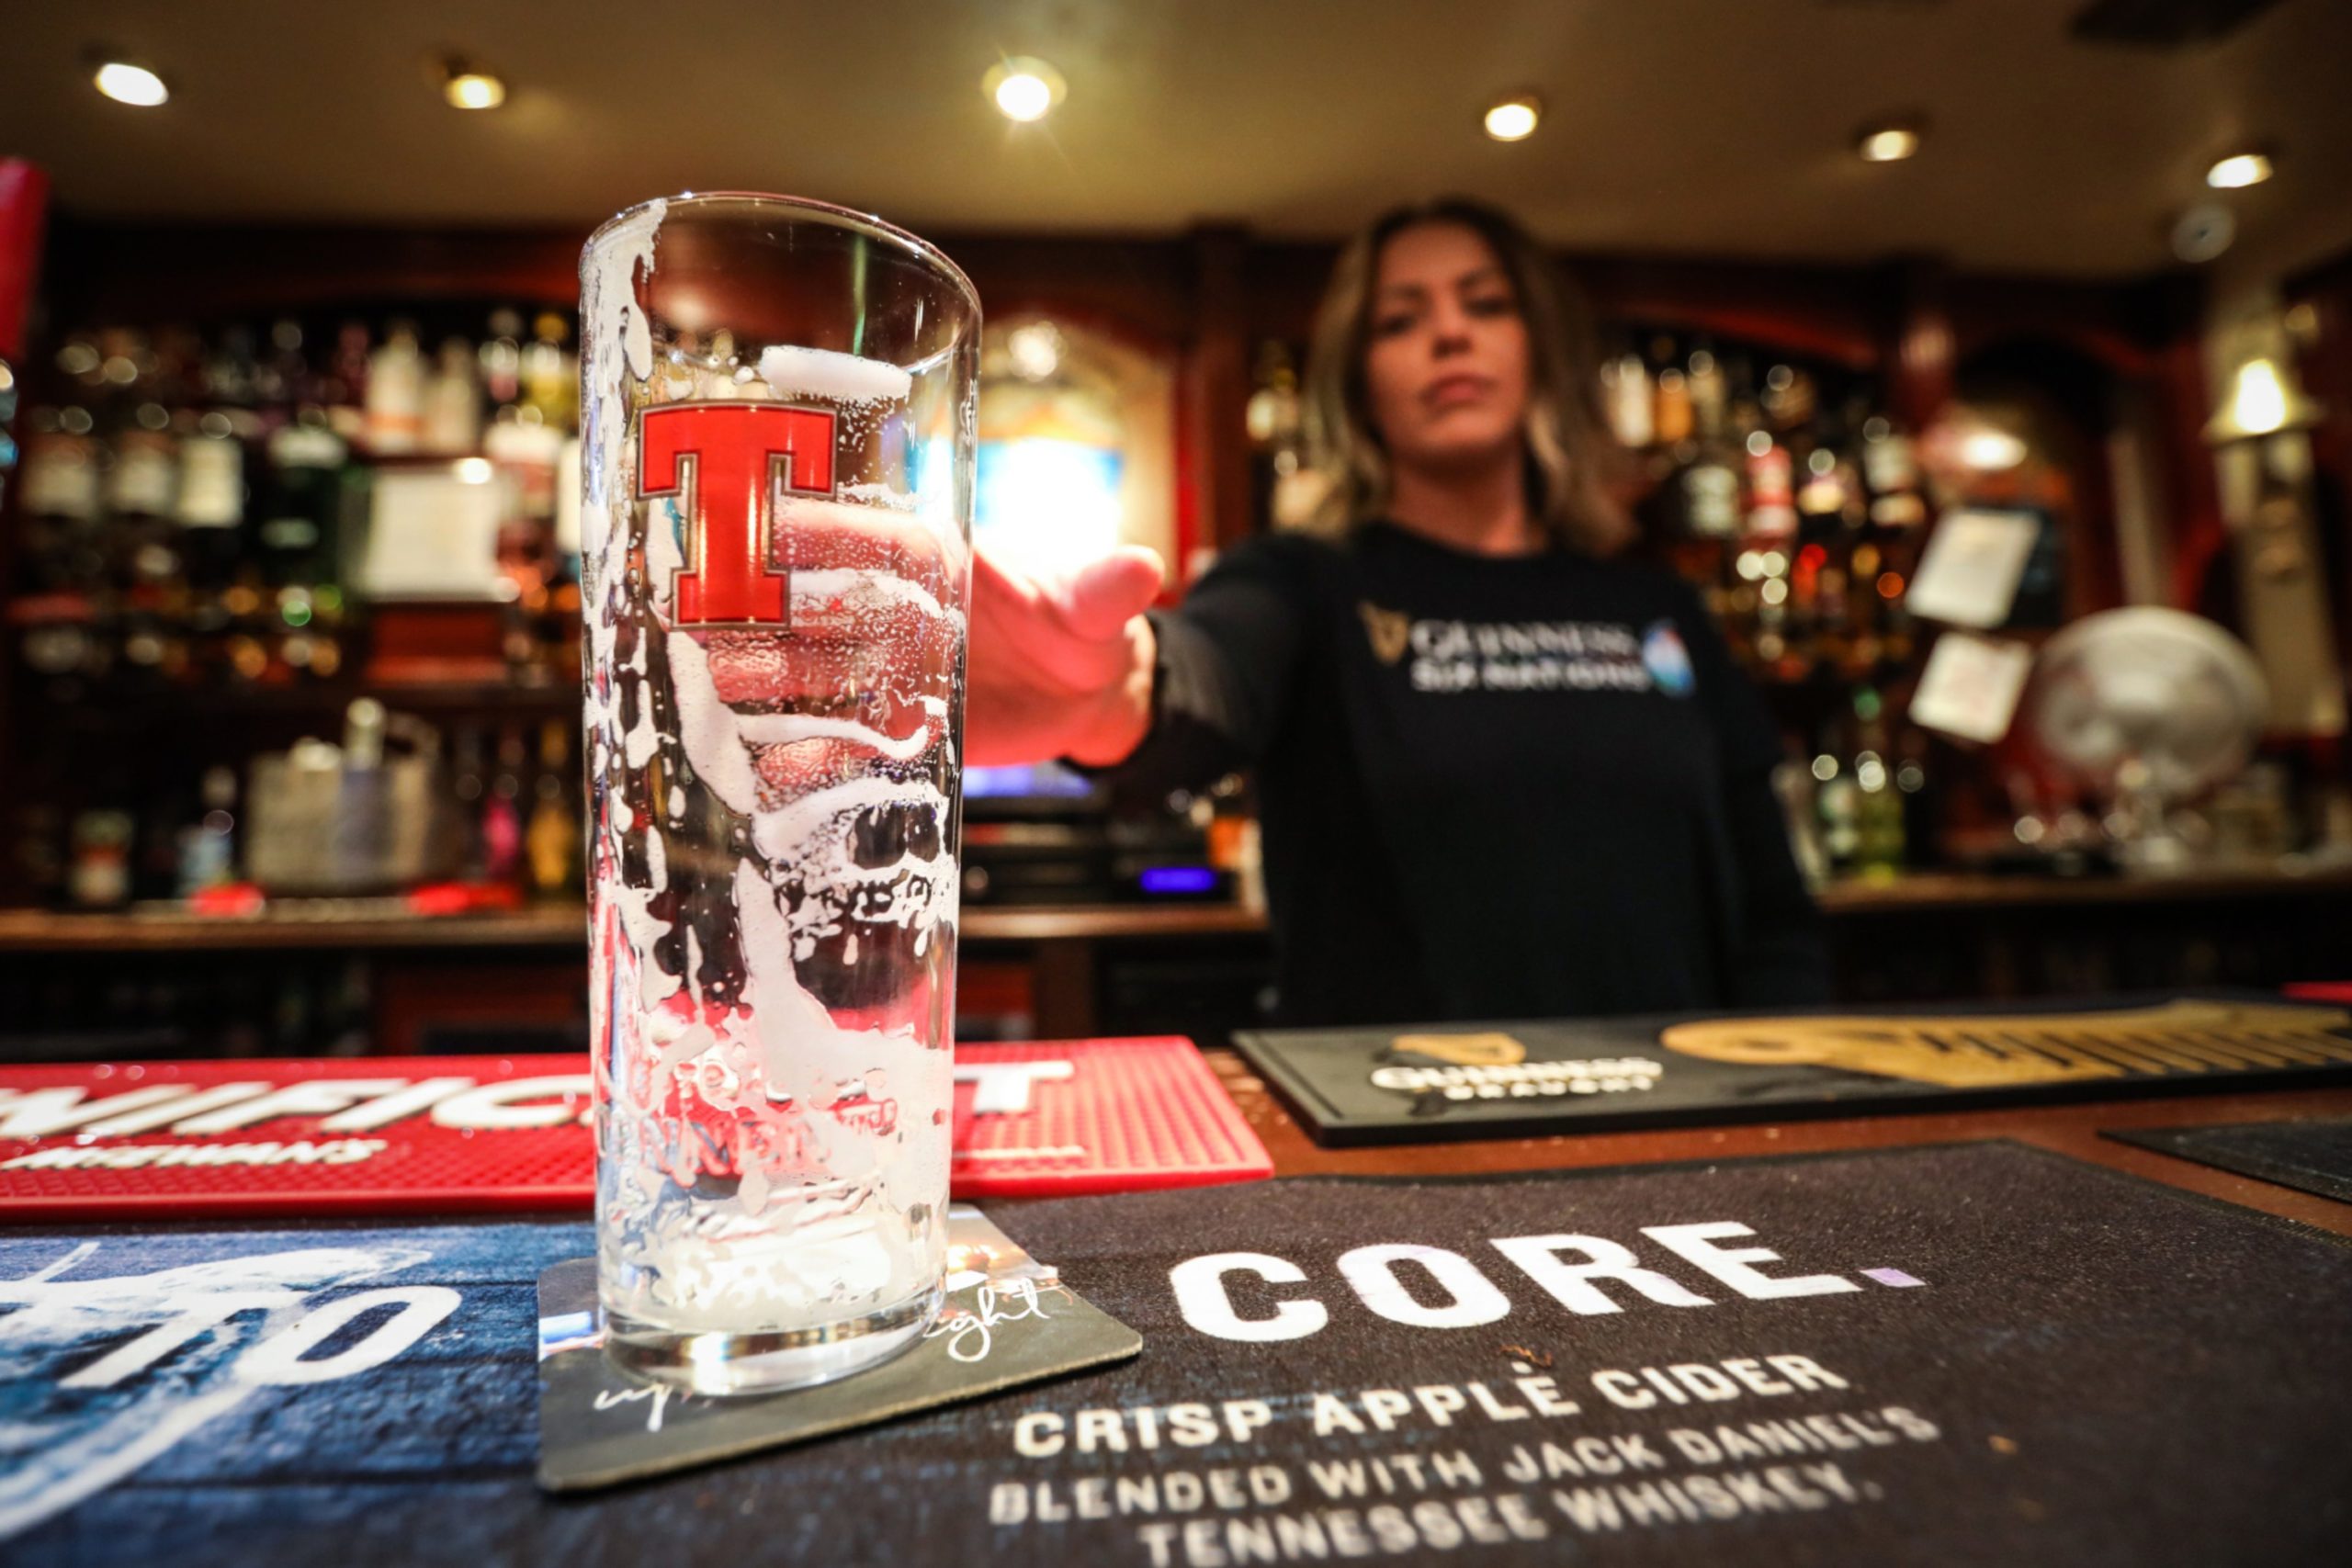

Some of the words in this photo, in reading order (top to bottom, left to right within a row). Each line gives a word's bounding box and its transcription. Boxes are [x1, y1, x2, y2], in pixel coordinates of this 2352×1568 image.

[635, 398, 839, 631] T
[1372, 1057, 1664, 1090] GUINNESS
[1169, 1221, 1927, 1342] CORE.
[1013, 1398, 1272, 1458] CRISP
[1312, 1374, 1580, 1437] APPLE
[1591, 1355, 1849, 1409] CIDER
[989, 1465, 1292, 1525] BLENDED
[1308, 1448, 1483, 1499] WITH
[1503, 1433, 1666, 1483] JACK
[1668, 1406, 1940, 1464] DANIEL'S
[1136, 1493, 1549, 1568] TENNESSEE
